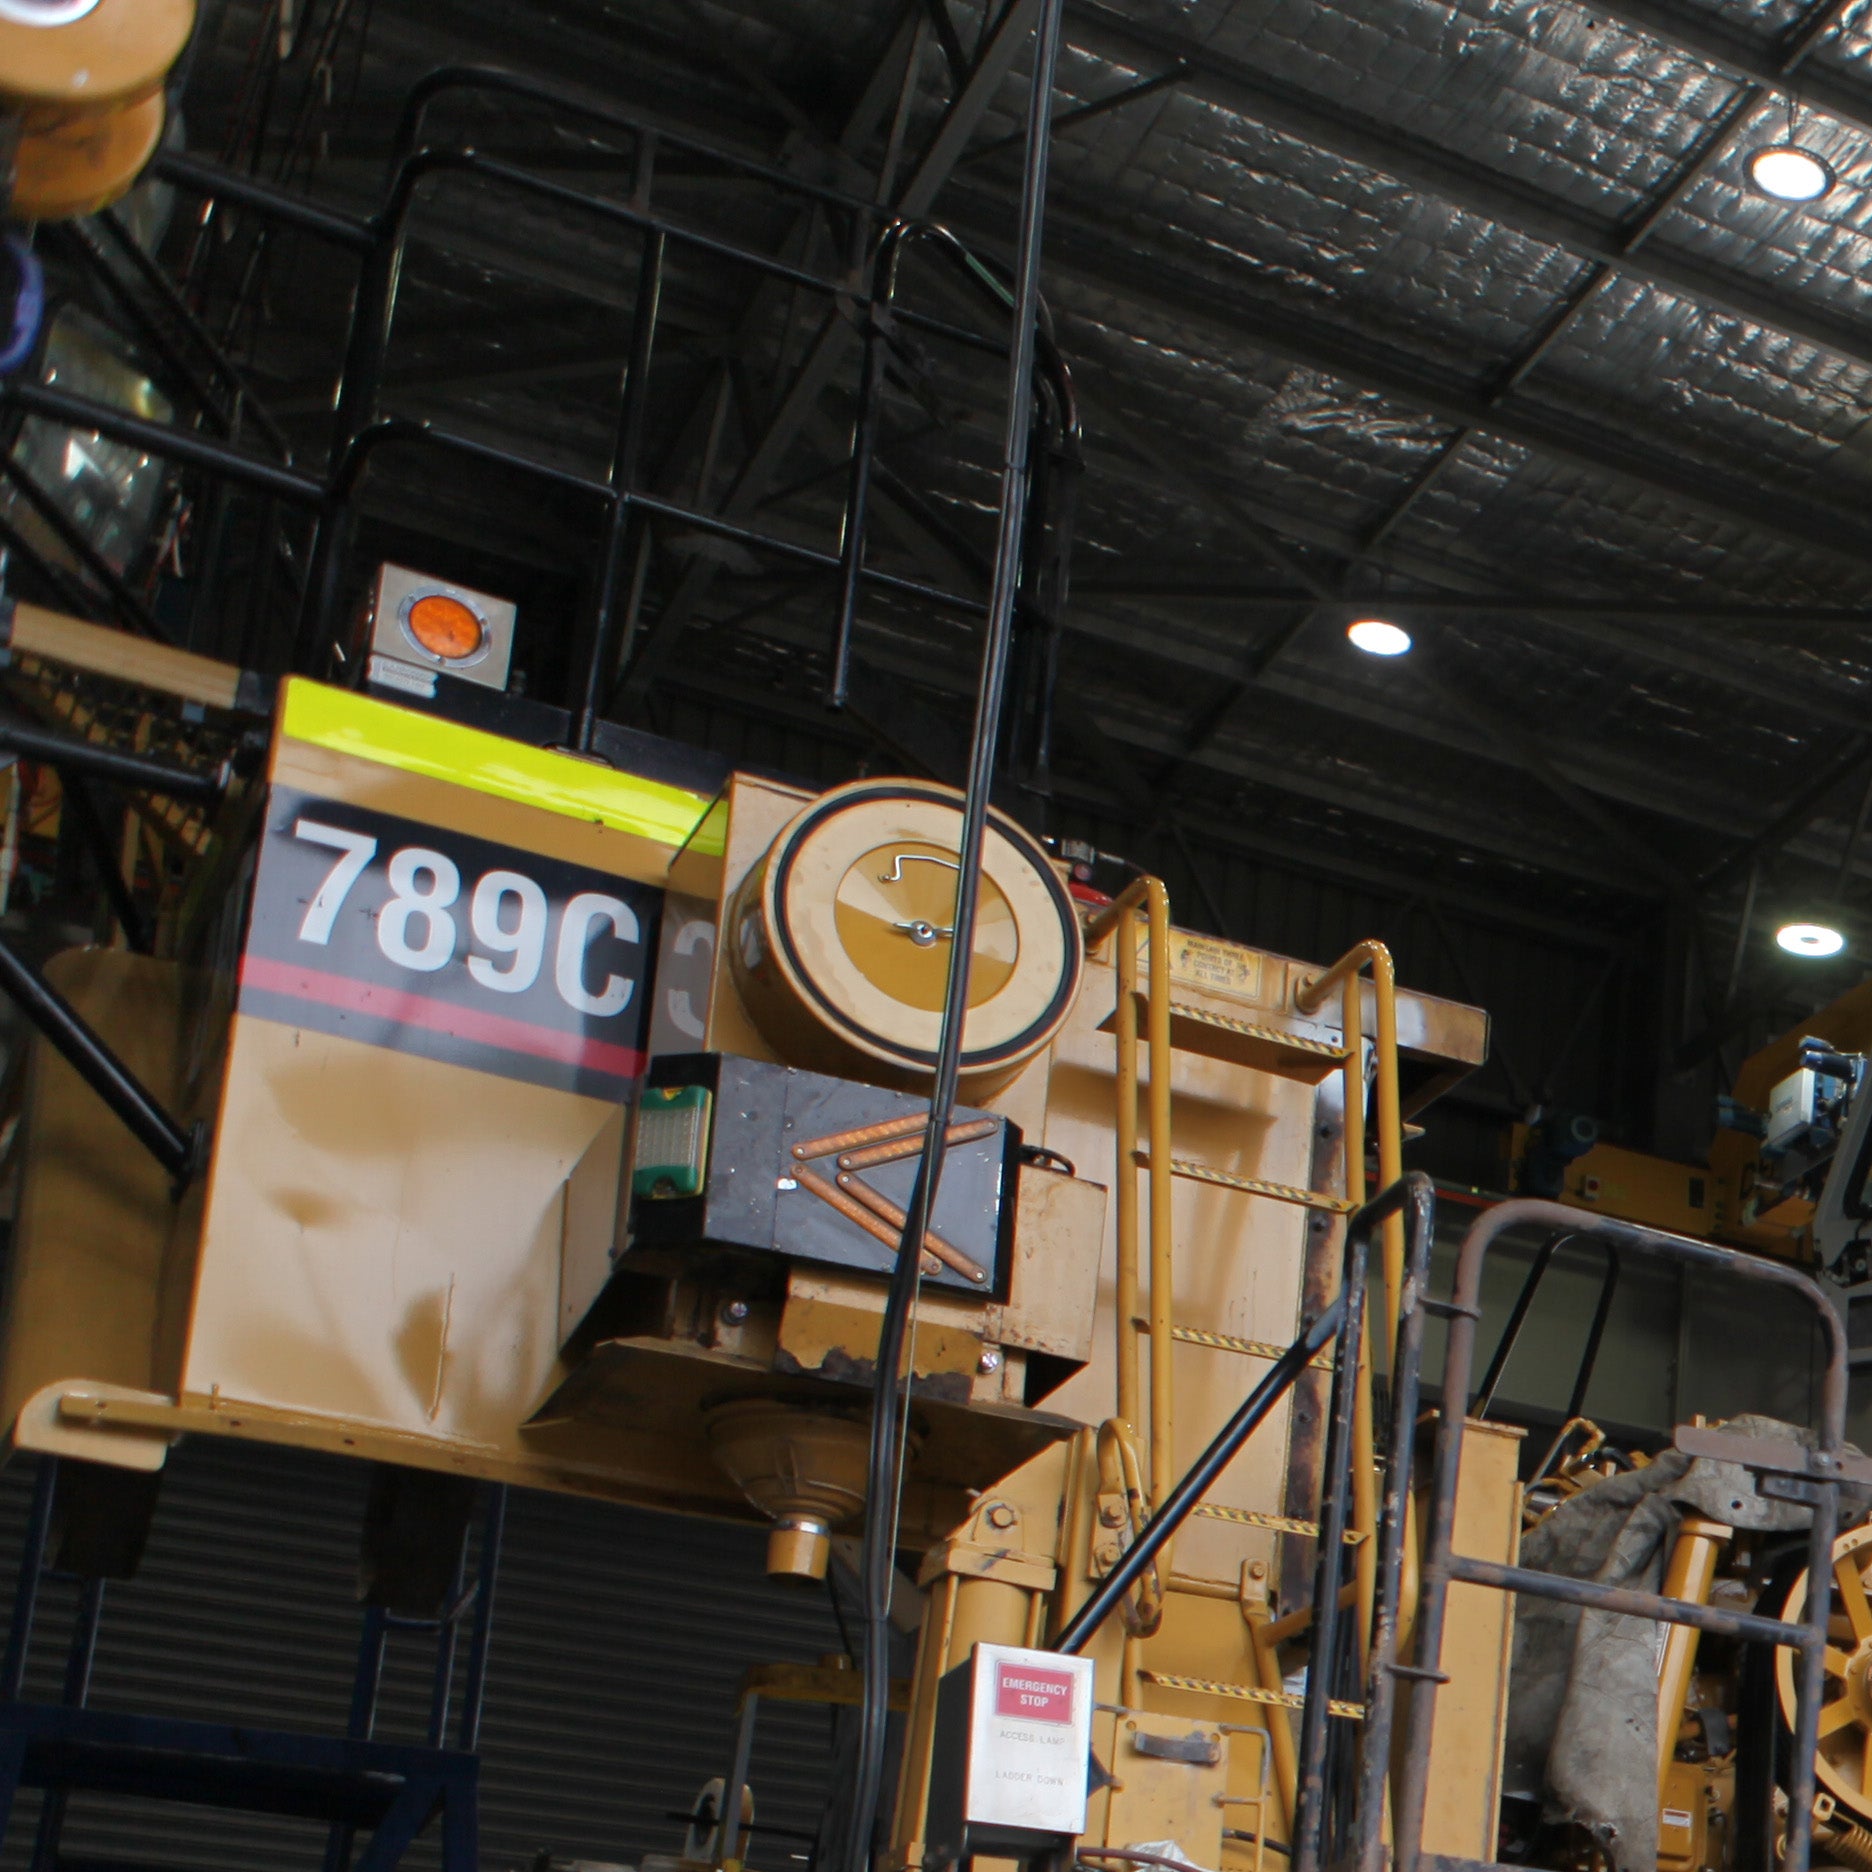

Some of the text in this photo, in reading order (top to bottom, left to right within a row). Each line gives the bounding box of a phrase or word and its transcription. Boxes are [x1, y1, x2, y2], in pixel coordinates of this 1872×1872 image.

[294, 818, 640, 1018] 789C
[1002, 1677, 1069, 1697] EMERGENCY
[1019, 1693, 1049, 1708] STOP
[1000, 1730, 1066, 1745] ACCESS LAMP
[995, 1770, 1065, 1787] LADDER DOWN
